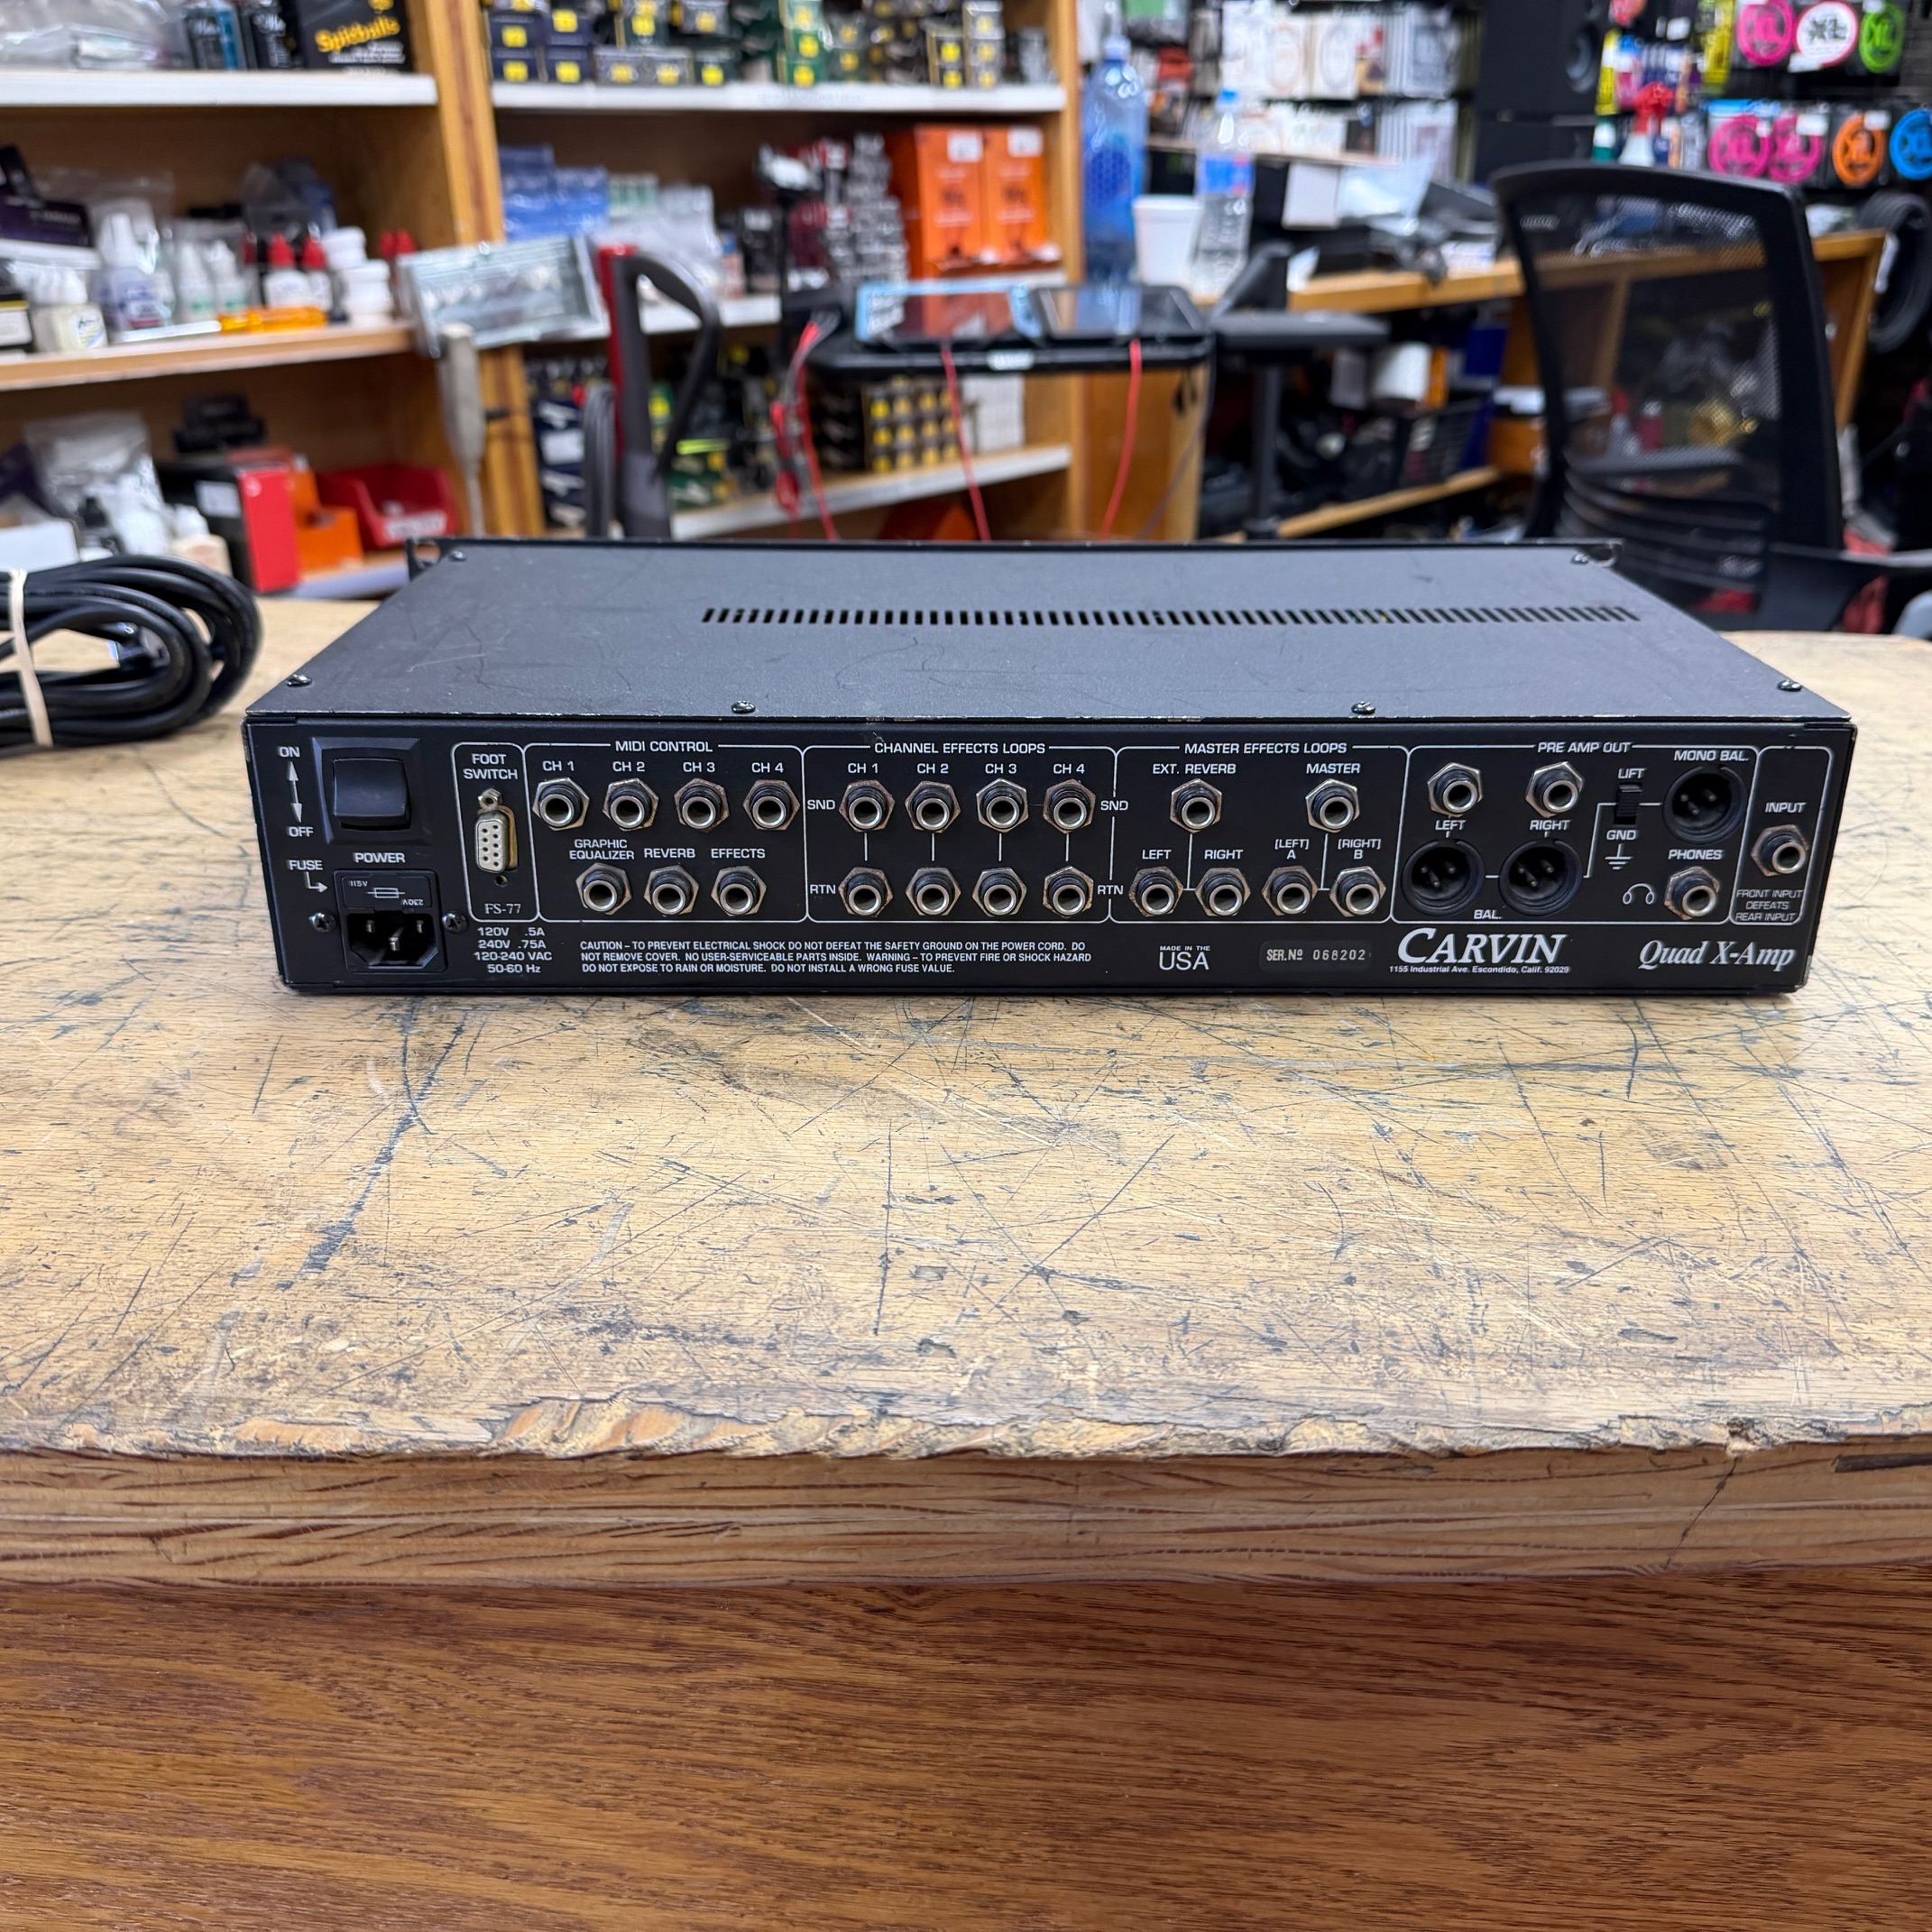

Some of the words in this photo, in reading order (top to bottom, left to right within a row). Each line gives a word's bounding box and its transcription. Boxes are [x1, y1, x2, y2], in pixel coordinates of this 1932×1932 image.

[616, 741, 645, 751] MIDI
[650, 741, 713, 751] CONTROL
[874, 742, 939, 754] CHANNEL
[943, 743, 998, 753] EFFECTS
[1003, 743, 1044, 753] LOOPS
[1185, 743, 1239, 753] MASTER
[1244, 743, 1299, 753] EFFECTS
[1304, 743, 1347, 753] LOOPS
[1538, 742, 1565, 752] PRE
[1568, 742, 1599, 752] AMP
[1603, 742, 1631, 752] OUT
[279, 747, 299, 757] ON
[1674, 750, 1716, 760] MONO
[1719, 750, 1750, 762] BAL.
[472, 754, 506, 764] FOOT
[543, 761, 562, 771] CH
[567, 761, 574, 770] 1
[612, 761, 631, 771] CH
[637, 762, 645, 771] 2
[683, 762, 702, 772] CH
[707, 762, 715, 772] 3
[752, 762, 769, 772] CH
[775, 763, 784, 772] 4
[848, 763, 866, 773] CH
[872, 763, 878, 773] 1
[917, 763, 935, 773] CH
[941, 764, 948, 773] 2
[986, 764, 1003, 773] CH
[1008, 764, 1017, 774] 3
[1053, 764, 1072, 774] CH
[1076, 764, 1084, 774] 4
[1153, 764, 1179, 774] EXT.
[1185, 764, 1236, 774] REVERB
[1306, 763, 1360, 773] MASTER
[464, 768, 518, 779] SWITCH
[1618, 768, 1644, 778] LIFT
[806, 799, 836, 810] SND
[1101, 801, 1128, 810] SND
[1765, 802, 1806, 813] INPUT
[1435, 820, 1467, 831] LEFT
[1529, 820, 1571, 831] RIGHT
[289, 827, 313, 837] OFF
[1606, 830, 1636, 840] GND
[575, 839, 627, 848] GRAPHIC
[1274, 839, 1310, 850] [LEFT]
[1338, 839, 1382, 850] [RIGHT]
[354, 852, 405, 862] POWER
[569, 851, 634, 860] EQUALIZER
[644, 849, 695, 858] REVERB
[712, 849, 765, 858] EFFECTS
[1143, 850, 1172, 859] LEFT
[1205, 850, 1243, 859] RIGHT
[1286, 851, 1297, 860] A
[1353, 851, 1363, 860] B
[1669, 850, 1723, 860] PHONES
[289, 860, 324, 870] FUSE
[351, 879, 367, 888] 115V
[809, 885, 836, 895] RTN
[1098, 885, 1123, 895] RTN
[1735, 888, 1770, 898] FRONT
[1771, 889, 1803, 898] INPUT
[485, 904, 520, 914] FS-77
[1745, 901, 1789, 910] DEFEATS
[1473, 909, 1503, 920] BAL.
[1734, 912, 1762, 921] REAR
[1764, 912, 1796, 922] INPUT
[477, 927, 509, 936] 120V
[525, 927, 545, 936] .5A
[478, 939, 510, 949] 240V
[519, 939, 546, 949] .75A
[580, 941, 622, 950] CAUTION
[632, 941, 645, 951] TO
[648, 941, 691, 951] PREVENT
[694, 941, 750, 951] ELECTRICAL
[753, 941, 786, 951] SHOCK
[788, 941, 802, 951] DO
[805, 941, 823, 951] NOT
[826, 941, 861, 951] DEFEAT
[864, 941, 882, 951] THE
[885, 941, 920, 951] SAFETY
[923, 941, 962, 951] GROUND
[965, 941, 979, 951] ON
[981, 941, 998, 951] THE
[1002, 941, 1035, 951] POWER
[1038, 941, 1066, 951] CORD.
[1072, 942, 1085, 951] DO
[1159, 944, 1182, 952] MADE
[1184, 944, 1192, 952] IN
[1195, 944, 1210, 952] THE
[1398, 928, 1567, 963] CARVIN
[474, 952, 524, 961] 120-240
[528, 952, 552, 961] VAC
[581, 952, 601, 961] NOT
[603, 952, 643, 961] REMOVE
[646, 952, 680, 961] COVER.
[685, 952, 699, 961] NO
[702, 952, 794, 961] USER-SERVICEABLE
[796, 952, 826, 961] PARTS
[829, 952, 861, 961] INSIDE.
[867, 952, 910, 962] WARNING
[920, 952, 933, 961] TO
[935, 952, 978, 961] PREVENT
[980, 952, 1000, 962] FIRE
[1003, 952, 1016, 962] OR
[1019, 952, 1051, 962] SHOCK
[1053, 952, 1091, 962] HAZARD
[1313, 950, 1365, 961] 068202
[1638, 940, 1708, 971] Quad
[1710, 940, 1797, 972] X-Amp
[1159, 952, 1210, 971] USA
[487, 963, 522, 973] 50-60
[526, 963, 540, 973] Hz
[583, 963, 596, 973] DO
[599, 963, 618, 973] NOT
[621, 963, 658, 973] EXPOSE
[660, 963, 673, 973] TO
[676, 963, 697, 972] RAIN
[700, 963, 713, 973] OR
[716, 963, 766, 973] MOISTURE.
[771, 963, 785, 973] DO
[787, 963, 805, 973] NOT
[809, 963, 846, 973] INSTALL
[849, 963, 855, 973] A
[858, 963, 893, 973] WRONG
[896, 963, 919, 973] FUSE
[922, 963, 954, 973] VALUE.
[1390, 965, 1408, 973] 1155
[1411, 965, 1449, 973] Industrial
[1451, 965, 1469, 973] Ave.
[1472, 965, 1518, 974] Escondido,
[1521, 965, 1541, 973] Calif.
[1545, 965, 1569, 974] 92029
